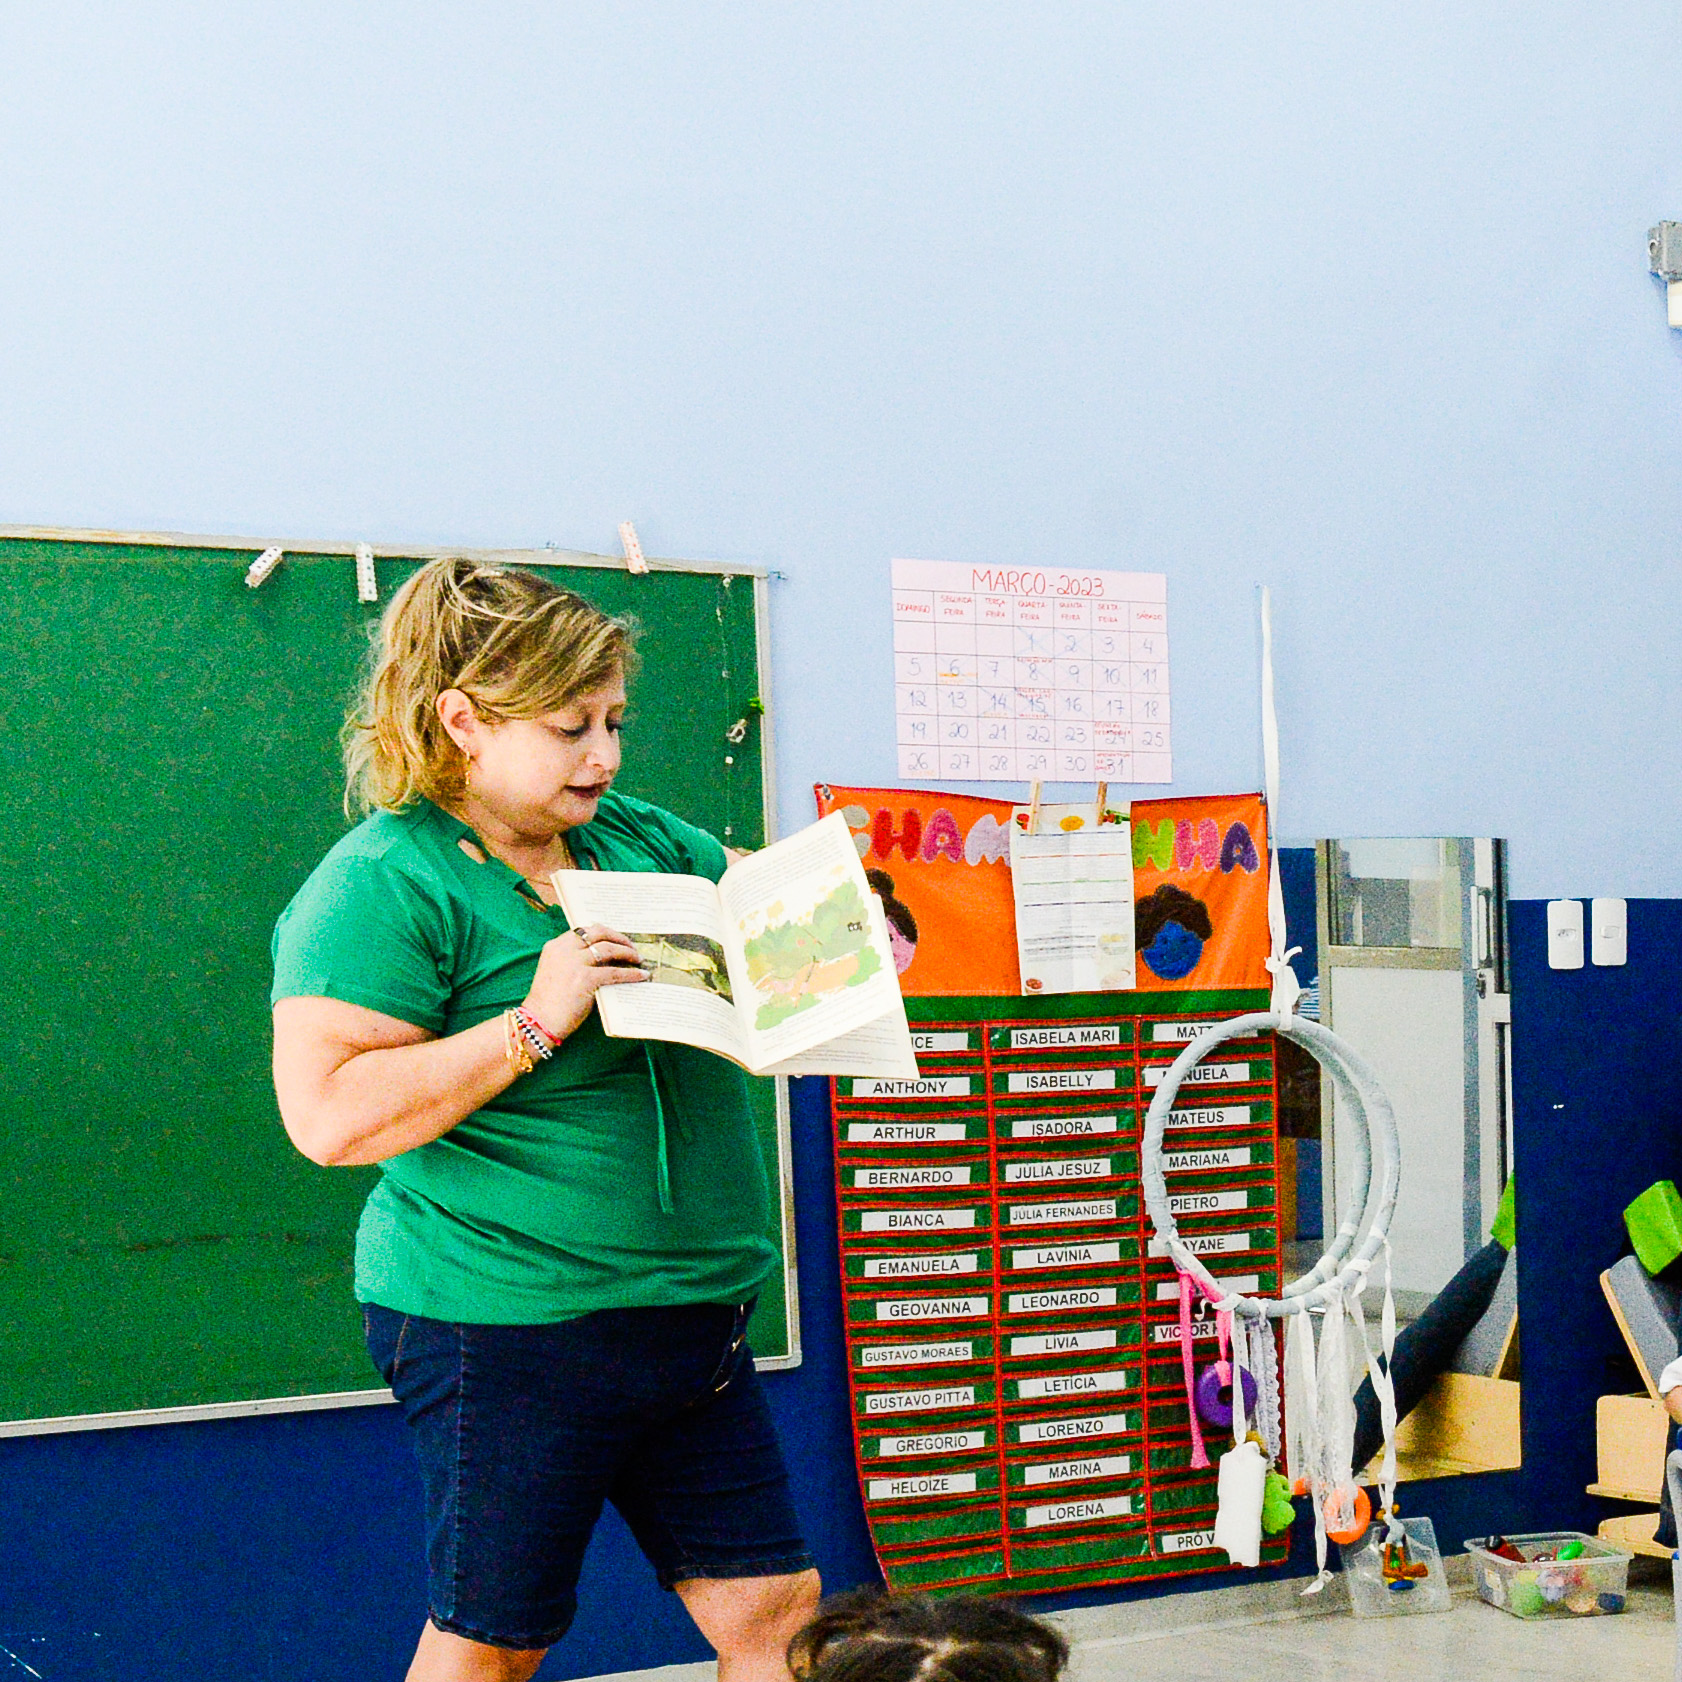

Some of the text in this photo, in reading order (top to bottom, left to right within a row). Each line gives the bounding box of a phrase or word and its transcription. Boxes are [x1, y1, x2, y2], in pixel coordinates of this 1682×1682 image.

[1064, 635, 1076, 651] 2
[1104, 636, 1115, 653] 3
[907, 658, 921, 676] 5
[949, 659, 961, 676] 6
[990, 661, 999, 679] 7
[1029, 662, 1039, 681] 8
[1068, 665, 1080, 683] 9
[1104, 668, 1120, 685] 10
[910, 688, 928, 708] 12
[948, 691, 967, 708] 13
[990, 693, 1007, 710] 14
[1065, 697, 1082, 712] 16
[1105, 699, 1125, 716] 17
[1144, 700, 1159, 718] 18
[911, 722, 926, 739] 19
[950, 723, 969, 739] 20
[988, 725, 1007, 741] 21
[1026, 726, 1051, 742] 22
[1064, 727, 1088, 744] 23
[1141, 730, 1164, 747] 25
[910, 752, 929, 770] 26
[950, 754, 970, 771] 27
[989, 755, 1008, 771] 28
[1028, 755, 1047, 771] 29
[1064, 755, 1088, 772] 30
[1015, 1029, 1115, 1046] ISABELA MARI
[873, 1080, 947, 1093] ANTHONY
[1026, 1074, 1093, 1088] ISABELLY
[1168, 1111, 1224, 1125] MATEUS
[873, 1127, 936, 1140] ARTHUR
[1032, 1121, 1093, 1136] ISADORA
[1169, 1153, 1230, 1168] MARIANA
[868, 1170, 953, 1185] BERNARDO
[1058, 1162, 1101, 1177] JESUZ
[1170, 1196, 1219, 1211] PIETRO
[888, 1213, 944, 1227] BIANCA
[1012, 1204, 1113, 1221] JÚLIA FERNANDES
[1181, 1237, 1225, 1251] AYANE
[878, 1259, 960, 1274] EMANUELA
[1022, 1291, 1100, 1308] LEONARDO
[889, 1301, 971, 1316] GEOVANNA
[1160, 1323, 1209, 1339] VICOR
[865, 1345, 970, 1362] GUSTAVO MORAES
[1044, 1374, 1097, 1392] LETÍCIA
[869, 1390, 971, 1409] GUSTAVO PITTA
[1038, 1419, 1104, 1438] LORENZO
[1049, 1461, 1102, 1477] MARINA
[1048, 1503, 1104, 1520] LORENA
